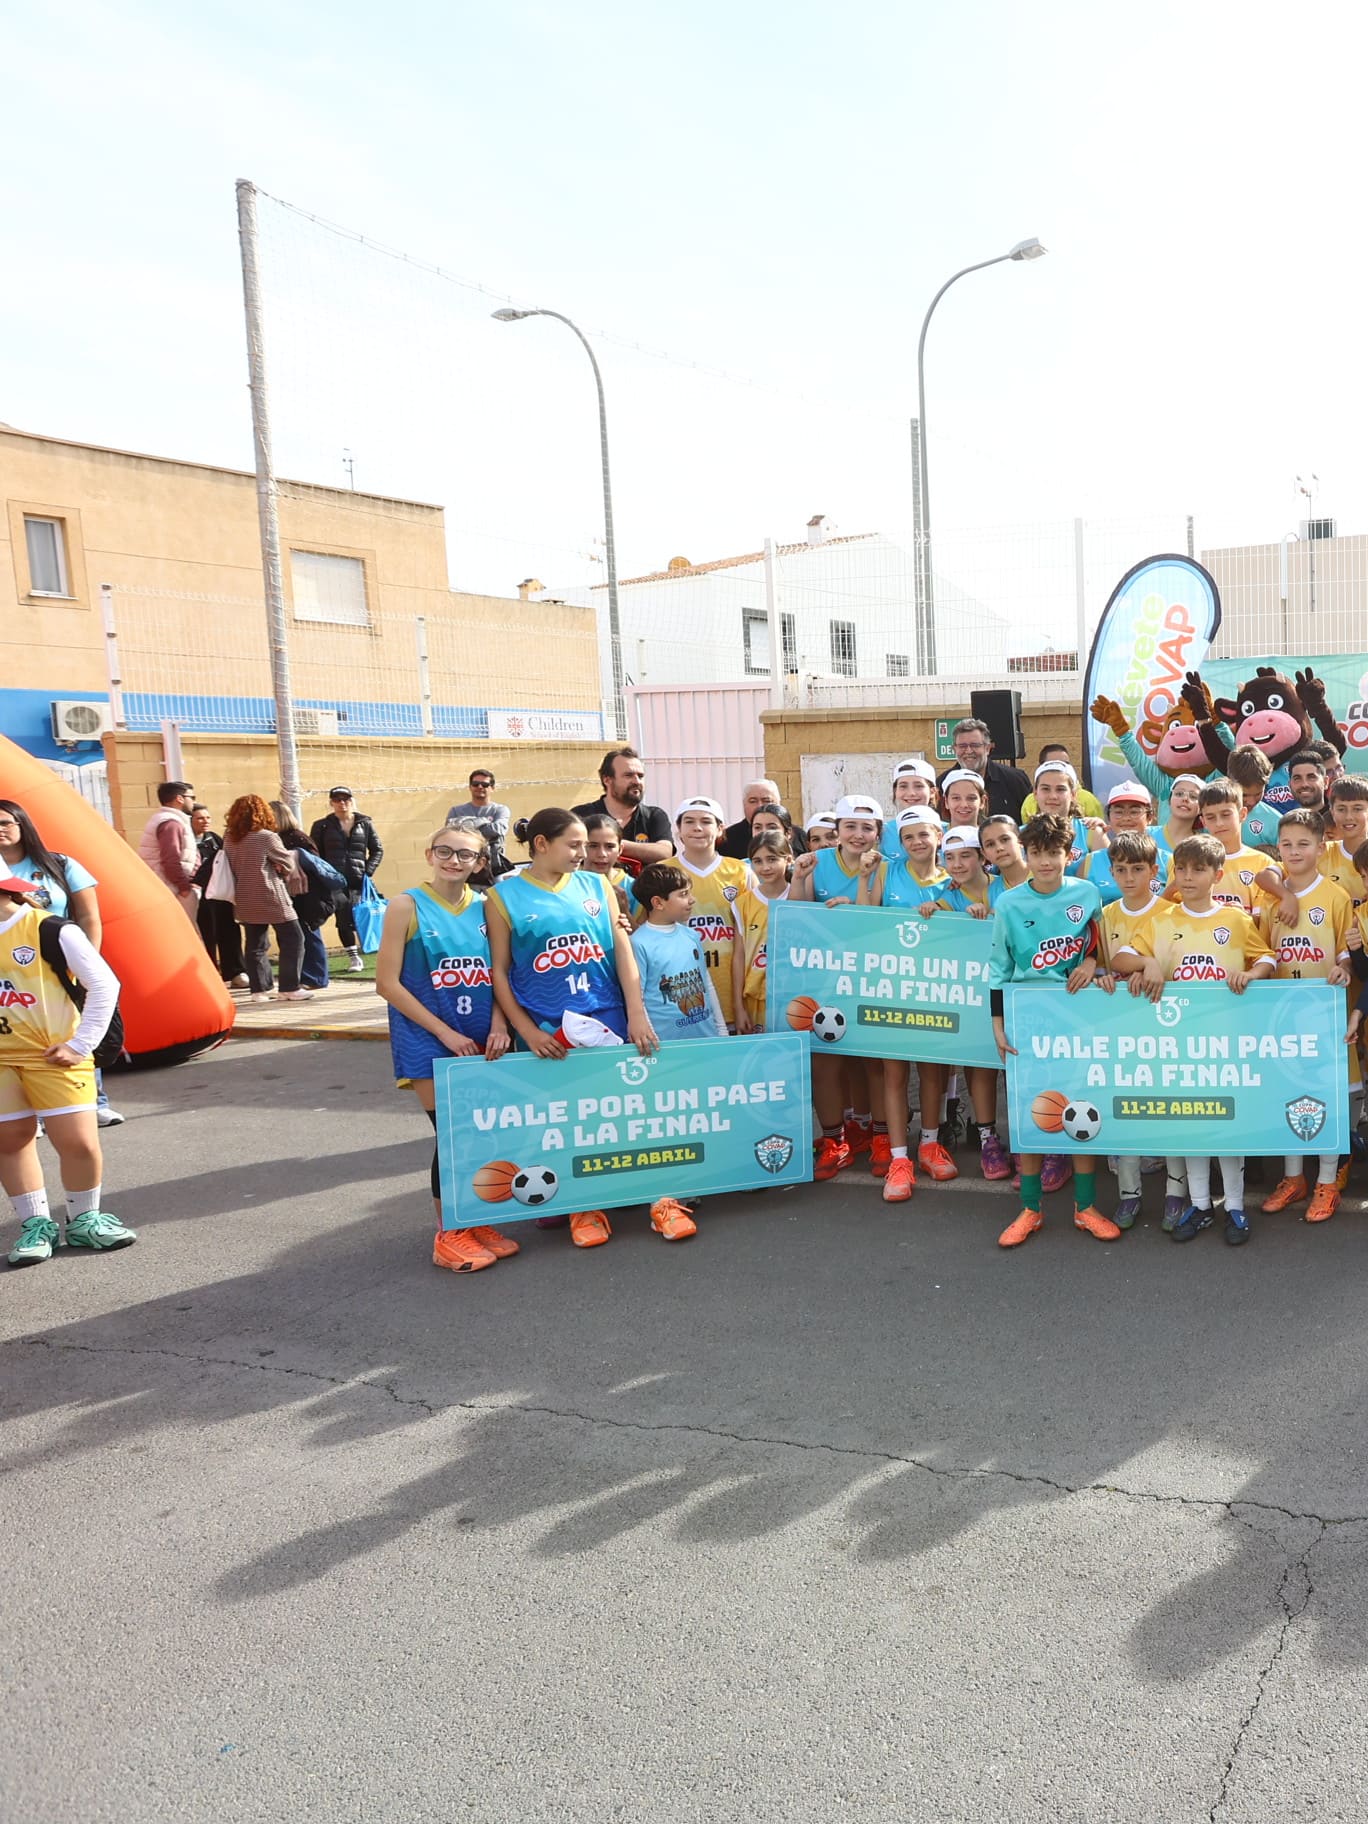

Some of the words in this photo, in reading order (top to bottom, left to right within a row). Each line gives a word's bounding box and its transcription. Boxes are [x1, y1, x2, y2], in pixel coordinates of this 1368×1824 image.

[528, 716, 584, 731] Children
[941, 745, 956, 755] DE
[689, 917, 724, 927] COPA
[548, 934, 590, 950] COPA
[1040, 936, 1074, 951] COPA
[1281, 936, 1311, 947] COPA
[704, 950, 719, 968] 11
[1032, 937, 1085, 969] COVAP
[1182, 955, 1214, 965] COPA
[1276, 948, 1325, 963] COVAP
[441, 958, 485, 969] COPA
[789, 947, 857, 972] VALE
[864, 953, 916, 976] POR
[923, 958, 958, 980] UN
[1173, 966, 1227, 981] COVAP
[565, 972, 590, 994] 14
[836, 976, 853, 995] A
[860, 977, 893, 998] LA
[900, 980, 983, 1006] FINAL
[456, 995, 472, 1015] 8
[864, 1009, 902, 1024] 11-12
[906, 1013, 952, 1028] ABRIL
[1031, 1035, 1109, 1059] VALE
[1118, 1036, 1178, 1059] POR
[1187, 1035, 1230, 1058] UN
[1238, 1034, 1319, 1058] PASE
[1087, 1064, 1106, 1086] A
[1114, 1064, 1153, 1087] LA
[1162, 1064, 1261, 1087] FINAL
[473, 1100, 569, 1131] VALE
[578, 1094, 646, 1121] POR
[654, 1088, 698, 1112] UN
[707, 1080, 786, 1107] PASE
[1121, 1101, 1166, 1115] 11-12
[1170, 1101, 1226, 1115] ABRIL
[542, 1128, 565, 1151] A
[574, 1122, 618, 1147] LA
[627, 1111, 731, 1141] FINAL
[582, 1154, 633, 1172] 11-12
[637, 1148, 696, 1165] ABRIL
